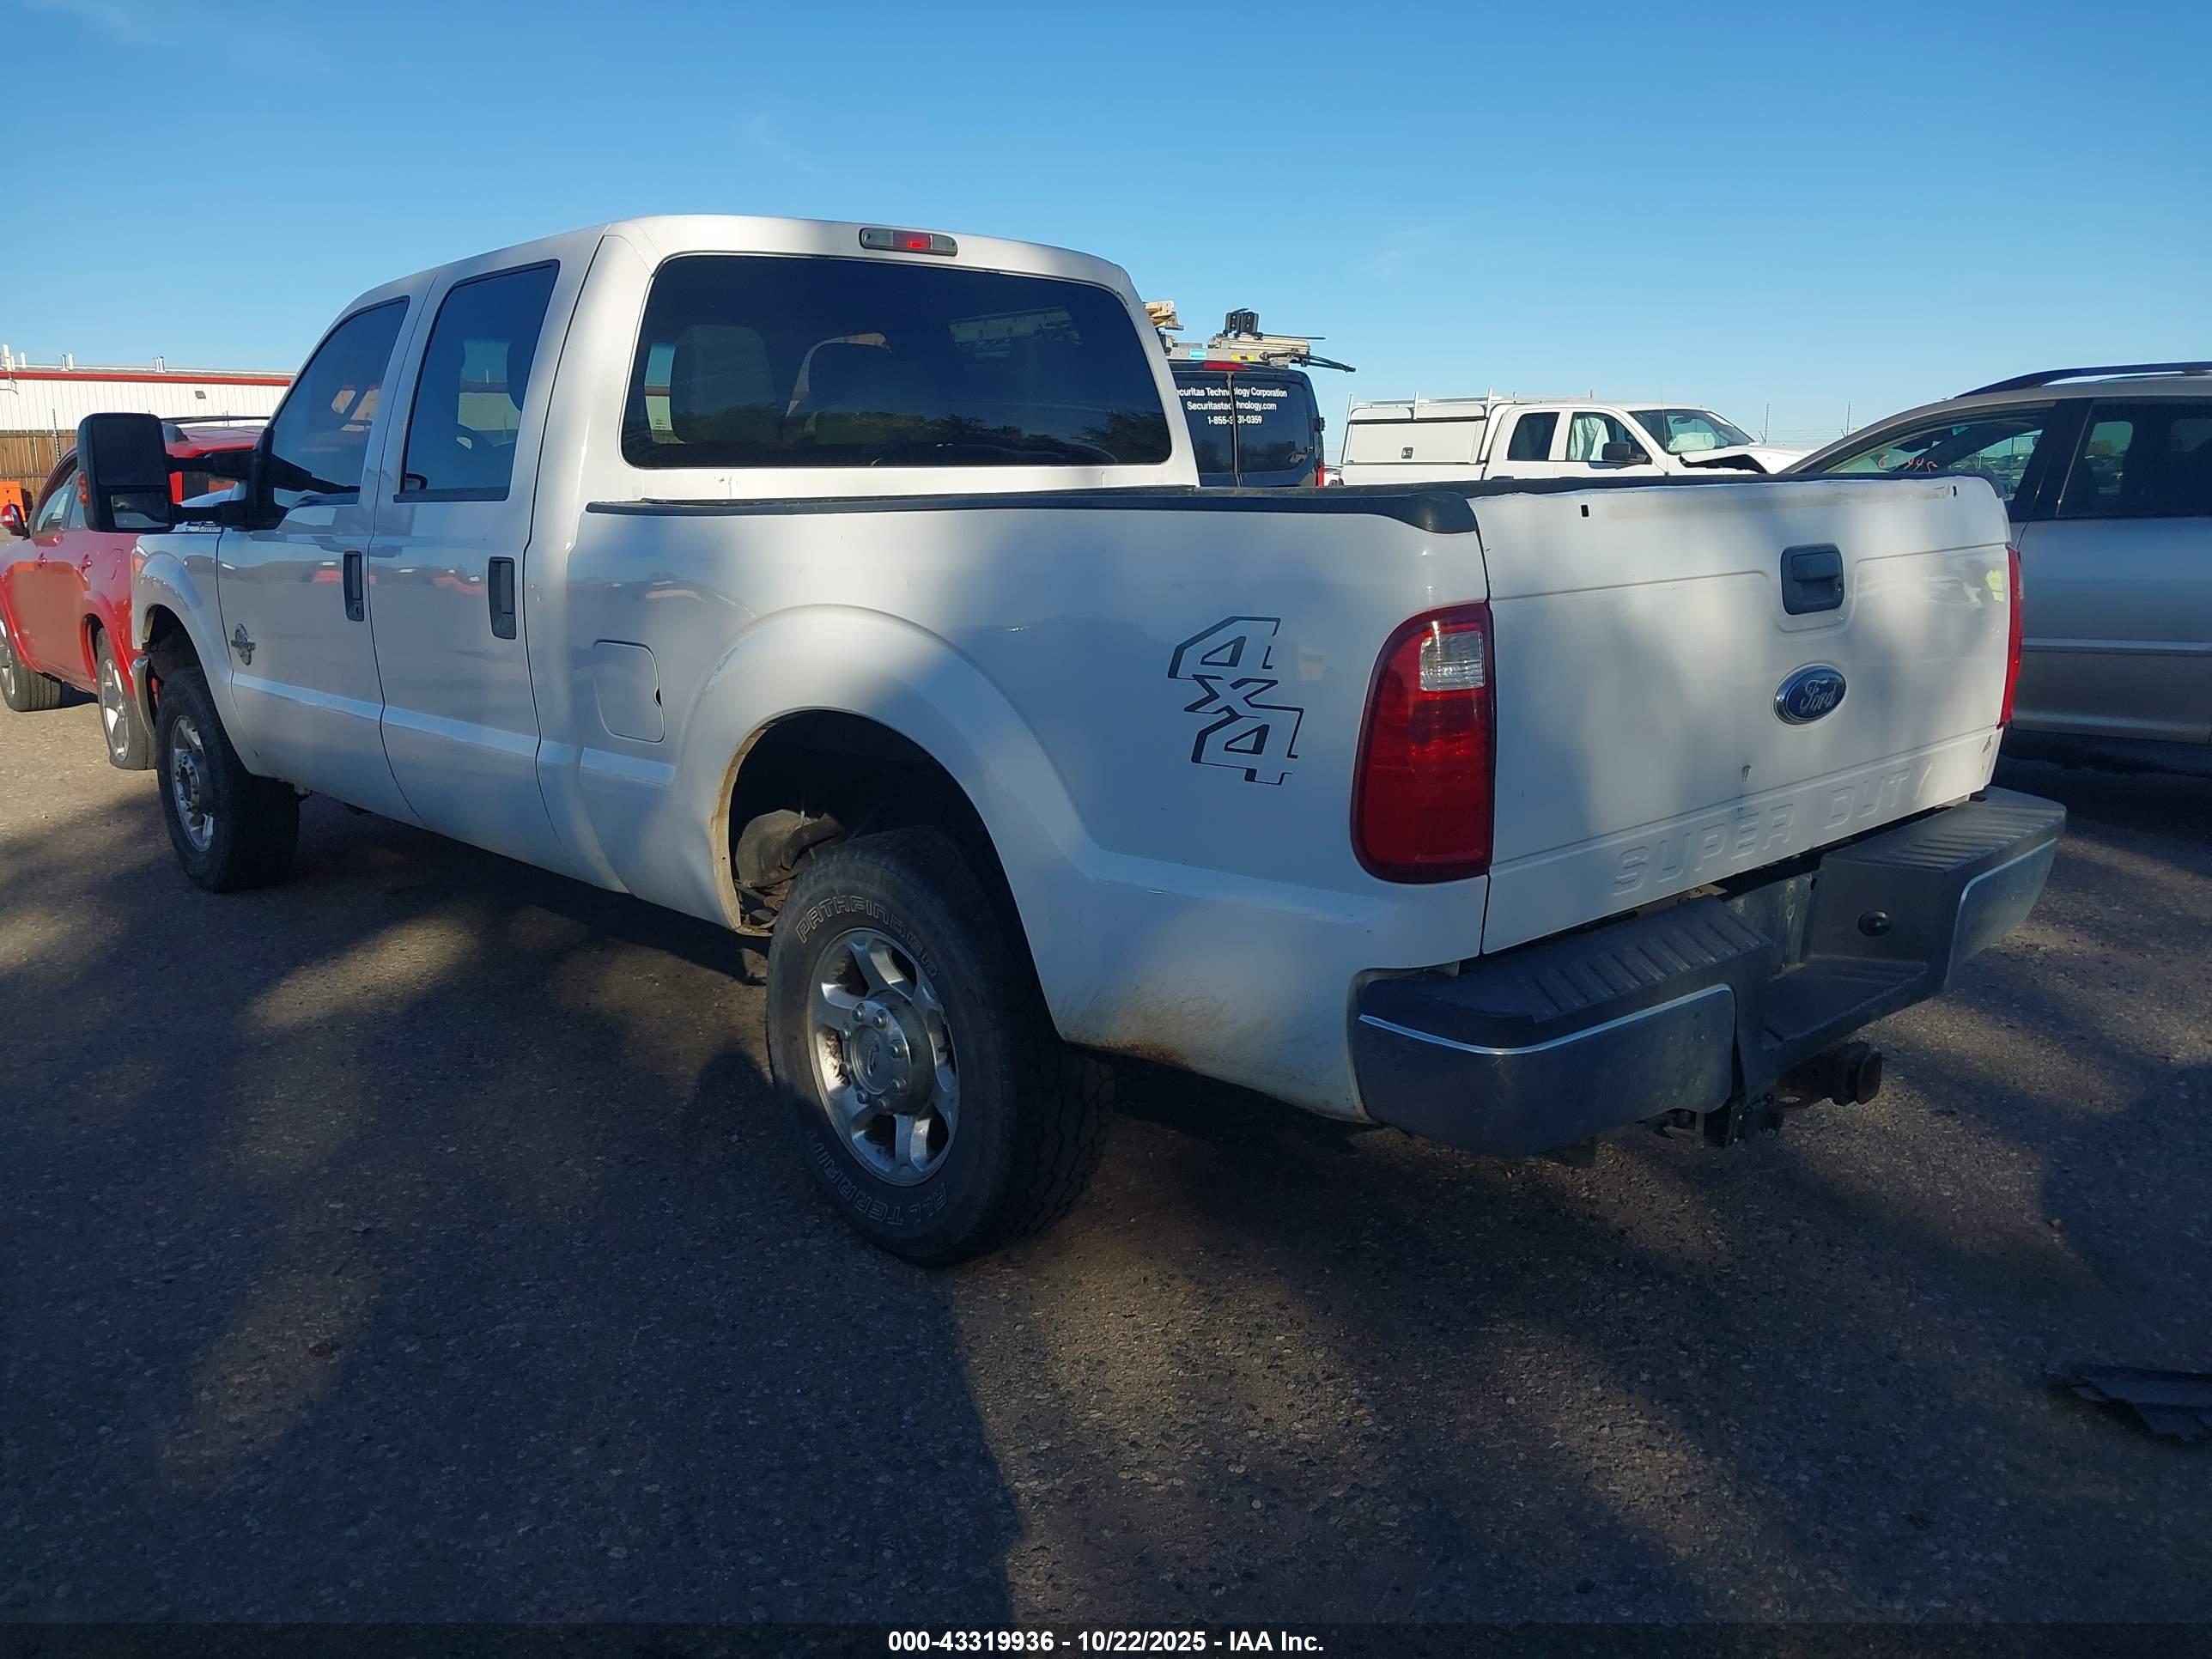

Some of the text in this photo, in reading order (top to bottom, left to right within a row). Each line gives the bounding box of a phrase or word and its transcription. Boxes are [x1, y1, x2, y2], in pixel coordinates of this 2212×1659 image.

[1205, 386, 1250, 398] Technology
[1251, 386, 1288, 398] Corporation
[1799, 678, 1838, 714] Ford
[1613, 761, 1933, 896] SUPER DUTY
